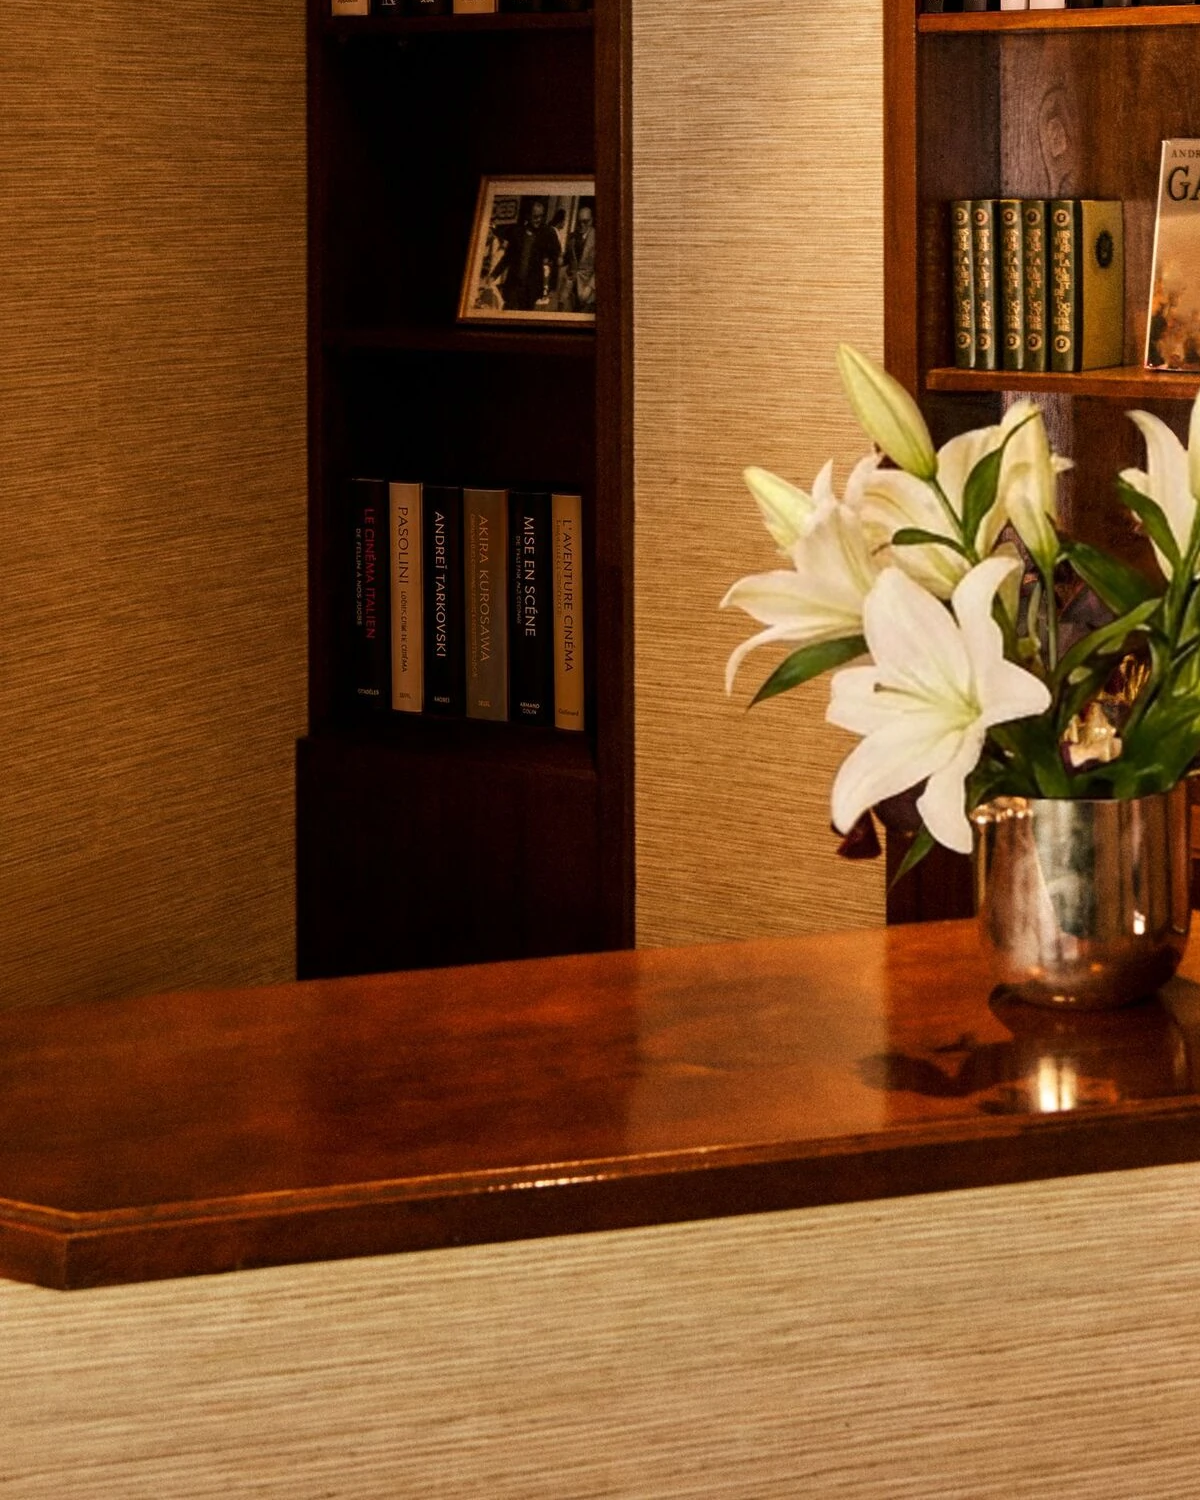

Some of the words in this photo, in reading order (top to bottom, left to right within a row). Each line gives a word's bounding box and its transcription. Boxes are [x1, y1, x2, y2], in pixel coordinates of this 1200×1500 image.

[364, 508, 375, 524] LE
[479, 515, 490, 563] AKIRA
[523, 516, 535, 554] MISE
[364, 529, 376, 582] CINÉMA
[398, 507, 409, 584] PASOLINI
[523, 560, 535, 580] EN
[365, 587, 376, 639] ITALIEN
[435, 575, 447, 658] TARKOVSKI
[479, 570, 491, 661] KUROSAWA
[563, 615, 576, 671] CINÉMA
